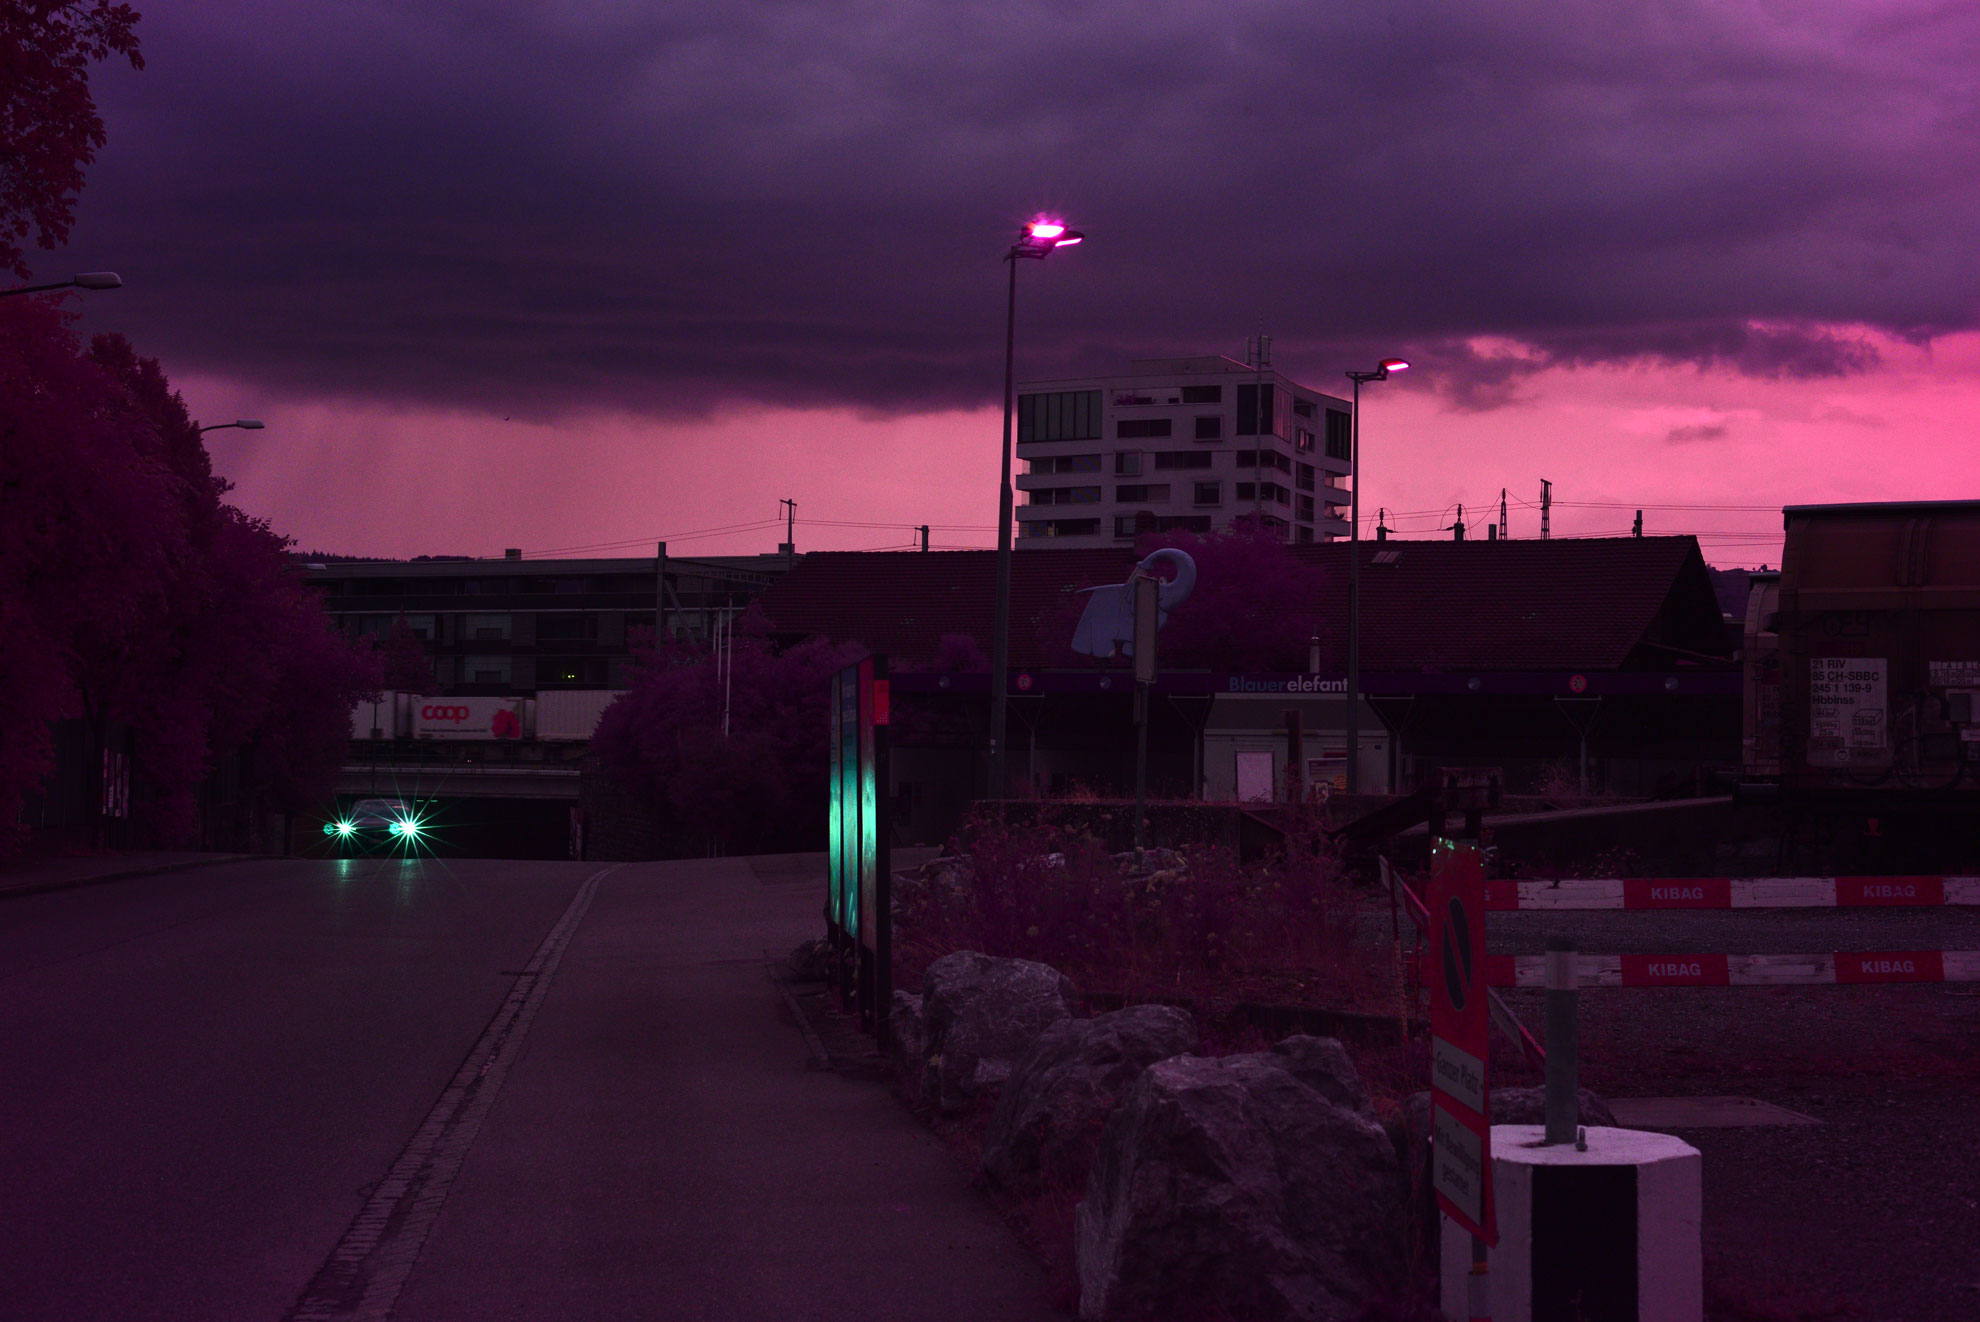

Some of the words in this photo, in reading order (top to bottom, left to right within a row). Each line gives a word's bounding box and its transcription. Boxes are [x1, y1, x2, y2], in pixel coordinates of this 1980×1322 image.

[1812, 659, 1824, 669] 21
[1827, 659, 1846, 669] RIV
[1812, 671, 1825, 682] 85
[1827, 671, 1880, 682] CH-SBBC
[1812, 683, 1831, 694] 245
[1843, 683, 1872, 694] 139-9
[1812, 694, 1856, 706] Hbbinss
[422, 705, 470, 724] coop
[1650, 886, 1704, 901] KIBAG
[1863, 884, 1916, 898] KIBAG
[1648, 963, 1702, 978] KIBAG
[1861, 960, 1915, 974] KIBAG
[1460, 1063, 1478, 1095] Platz
